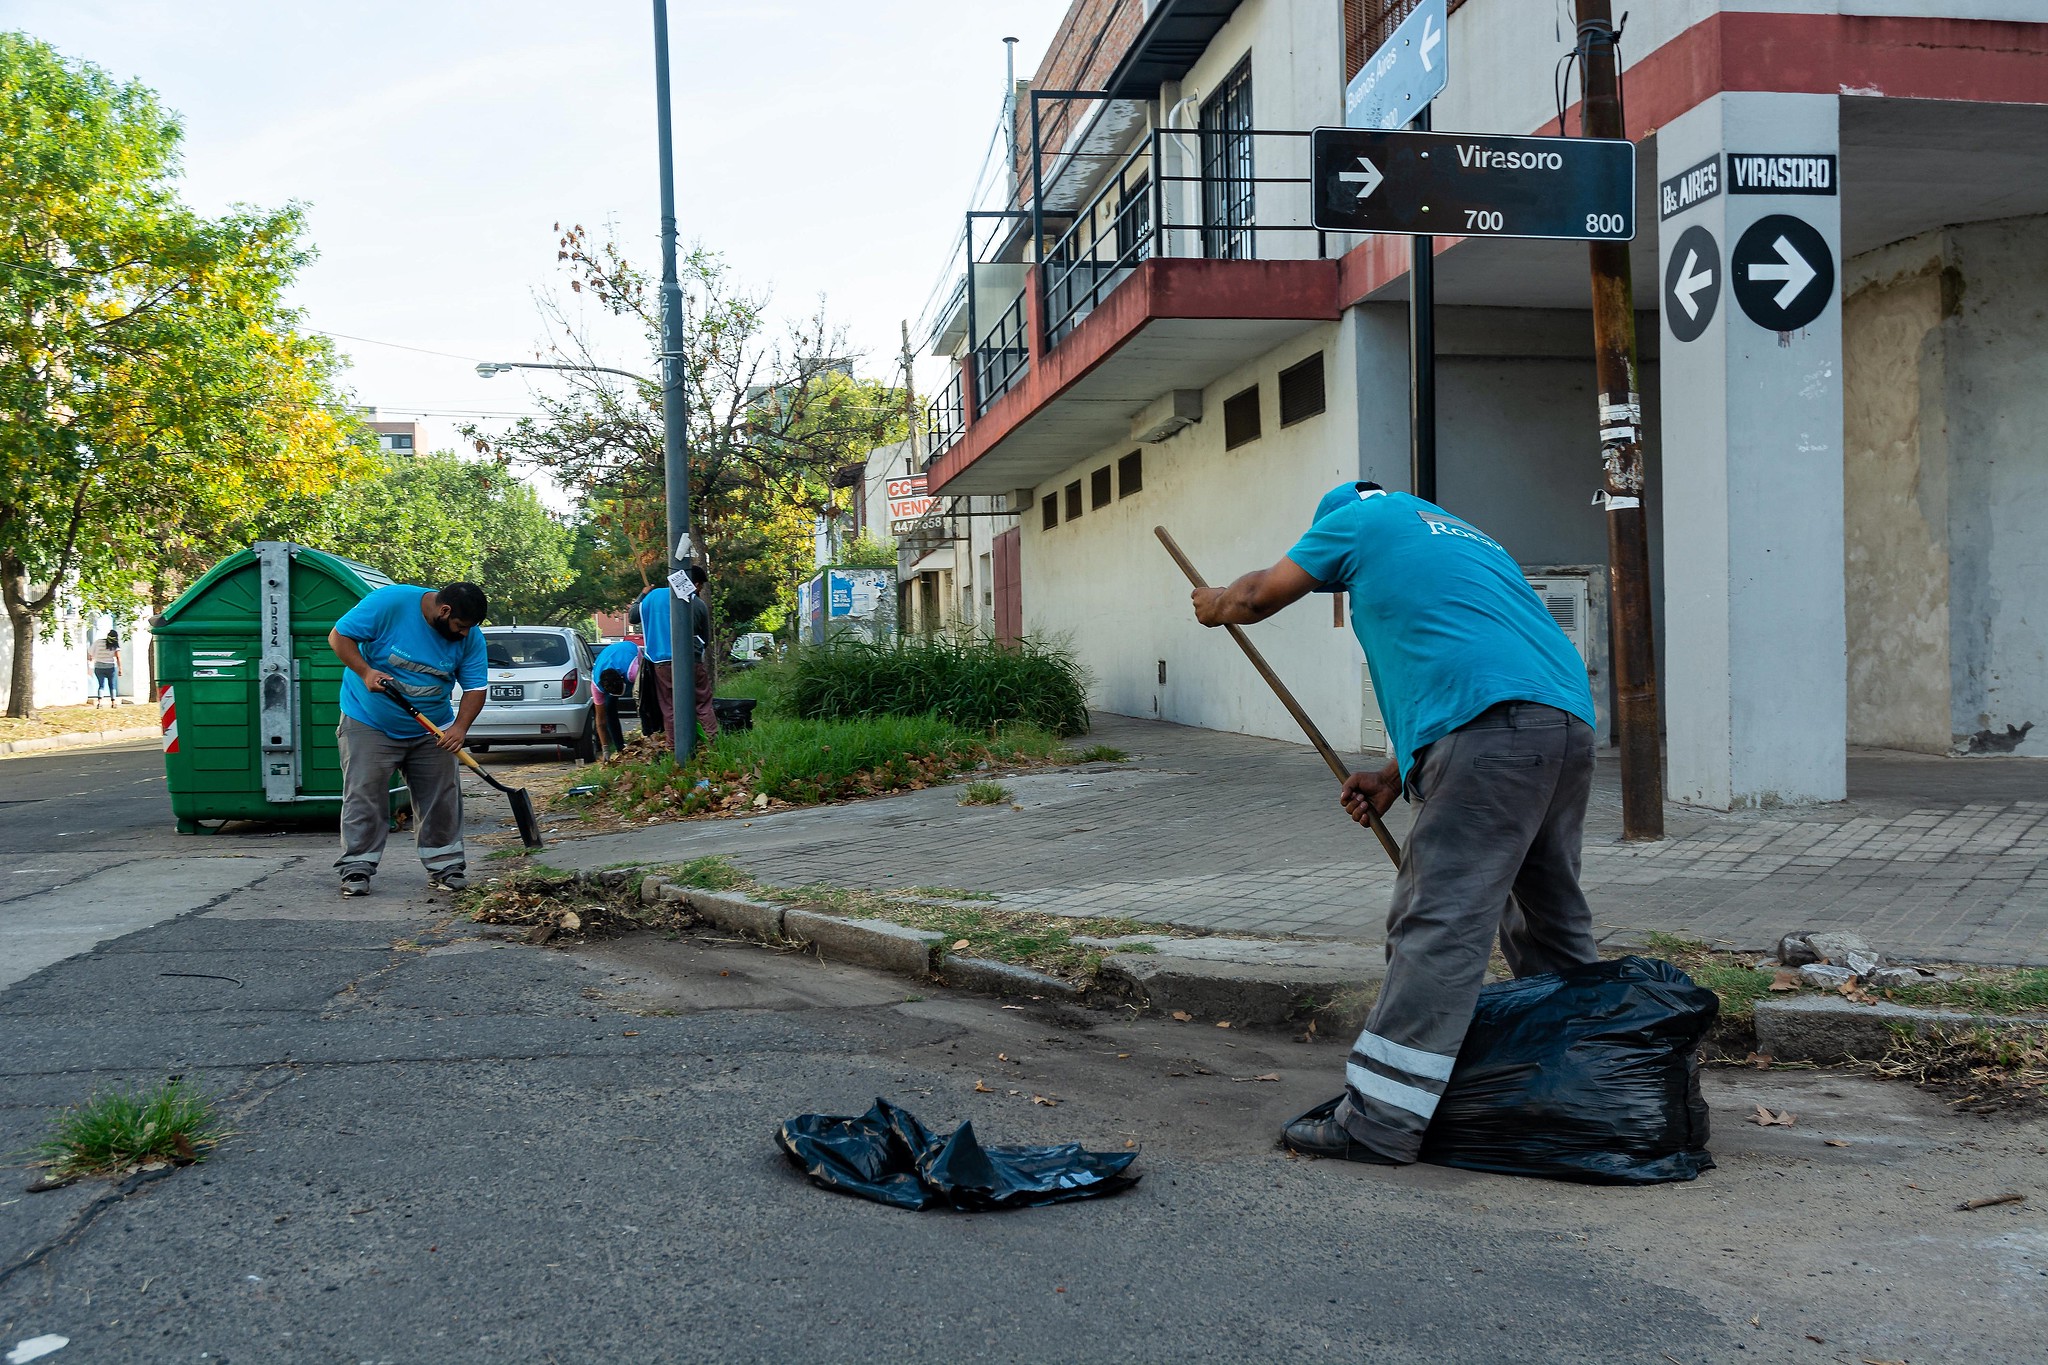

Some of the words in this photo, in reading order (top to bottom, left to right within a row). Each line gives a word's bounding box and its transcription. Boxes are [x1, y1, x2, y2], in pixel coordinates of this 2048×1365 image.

[1456, 144, 1563, 170] Virasoro
[1679, 162, 1718, 207] AIRES
[1734, 157, 1830, 188] VIRASORO
[1464, 209, 1504, 231] 700
[1585, 213, 1624, 233] 800
[508, 688, 522, 697] 513
